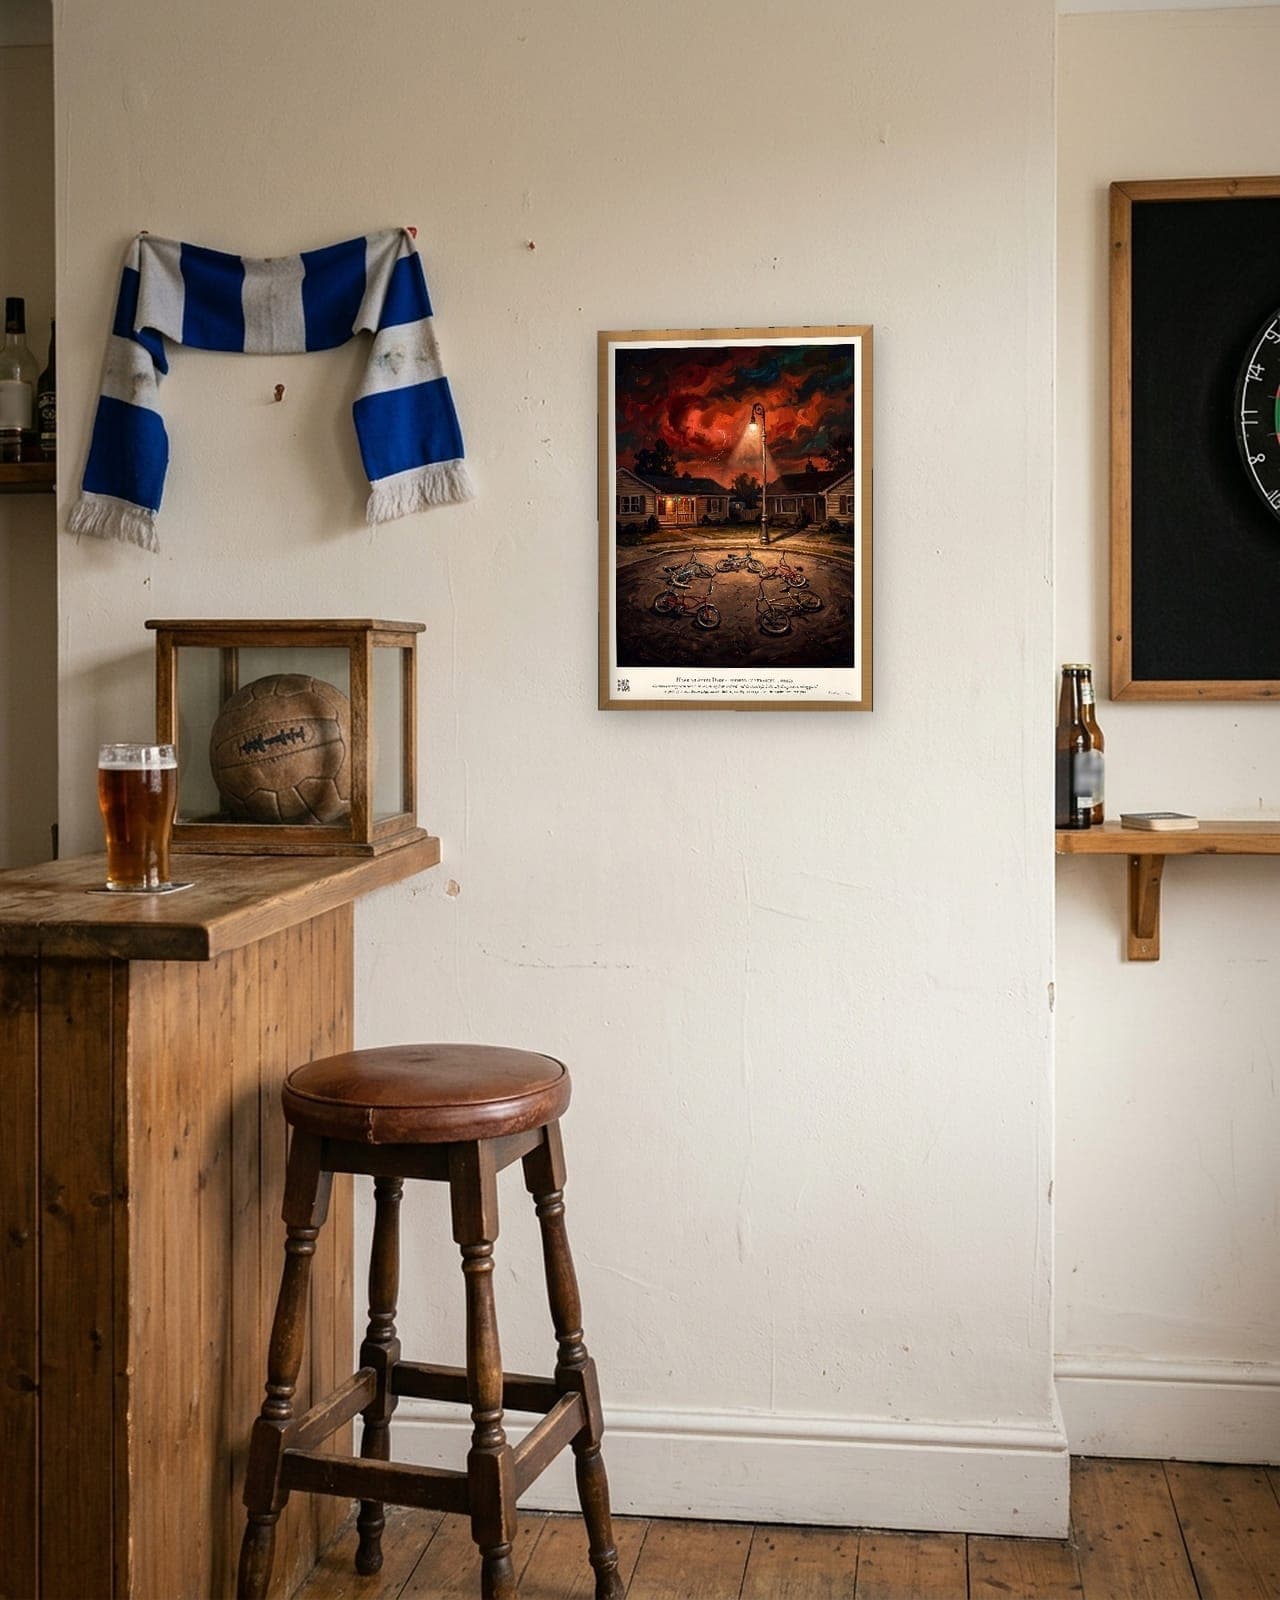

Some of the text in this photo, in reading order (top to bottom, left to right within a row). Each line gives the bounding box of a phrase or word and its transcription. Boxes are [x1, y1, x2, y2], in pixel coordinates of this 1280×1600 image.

[1247, 364, 1265, 381] 14
[1241, 410, 1259, 425] 11
[1248, 453, 1266, 464] 8
